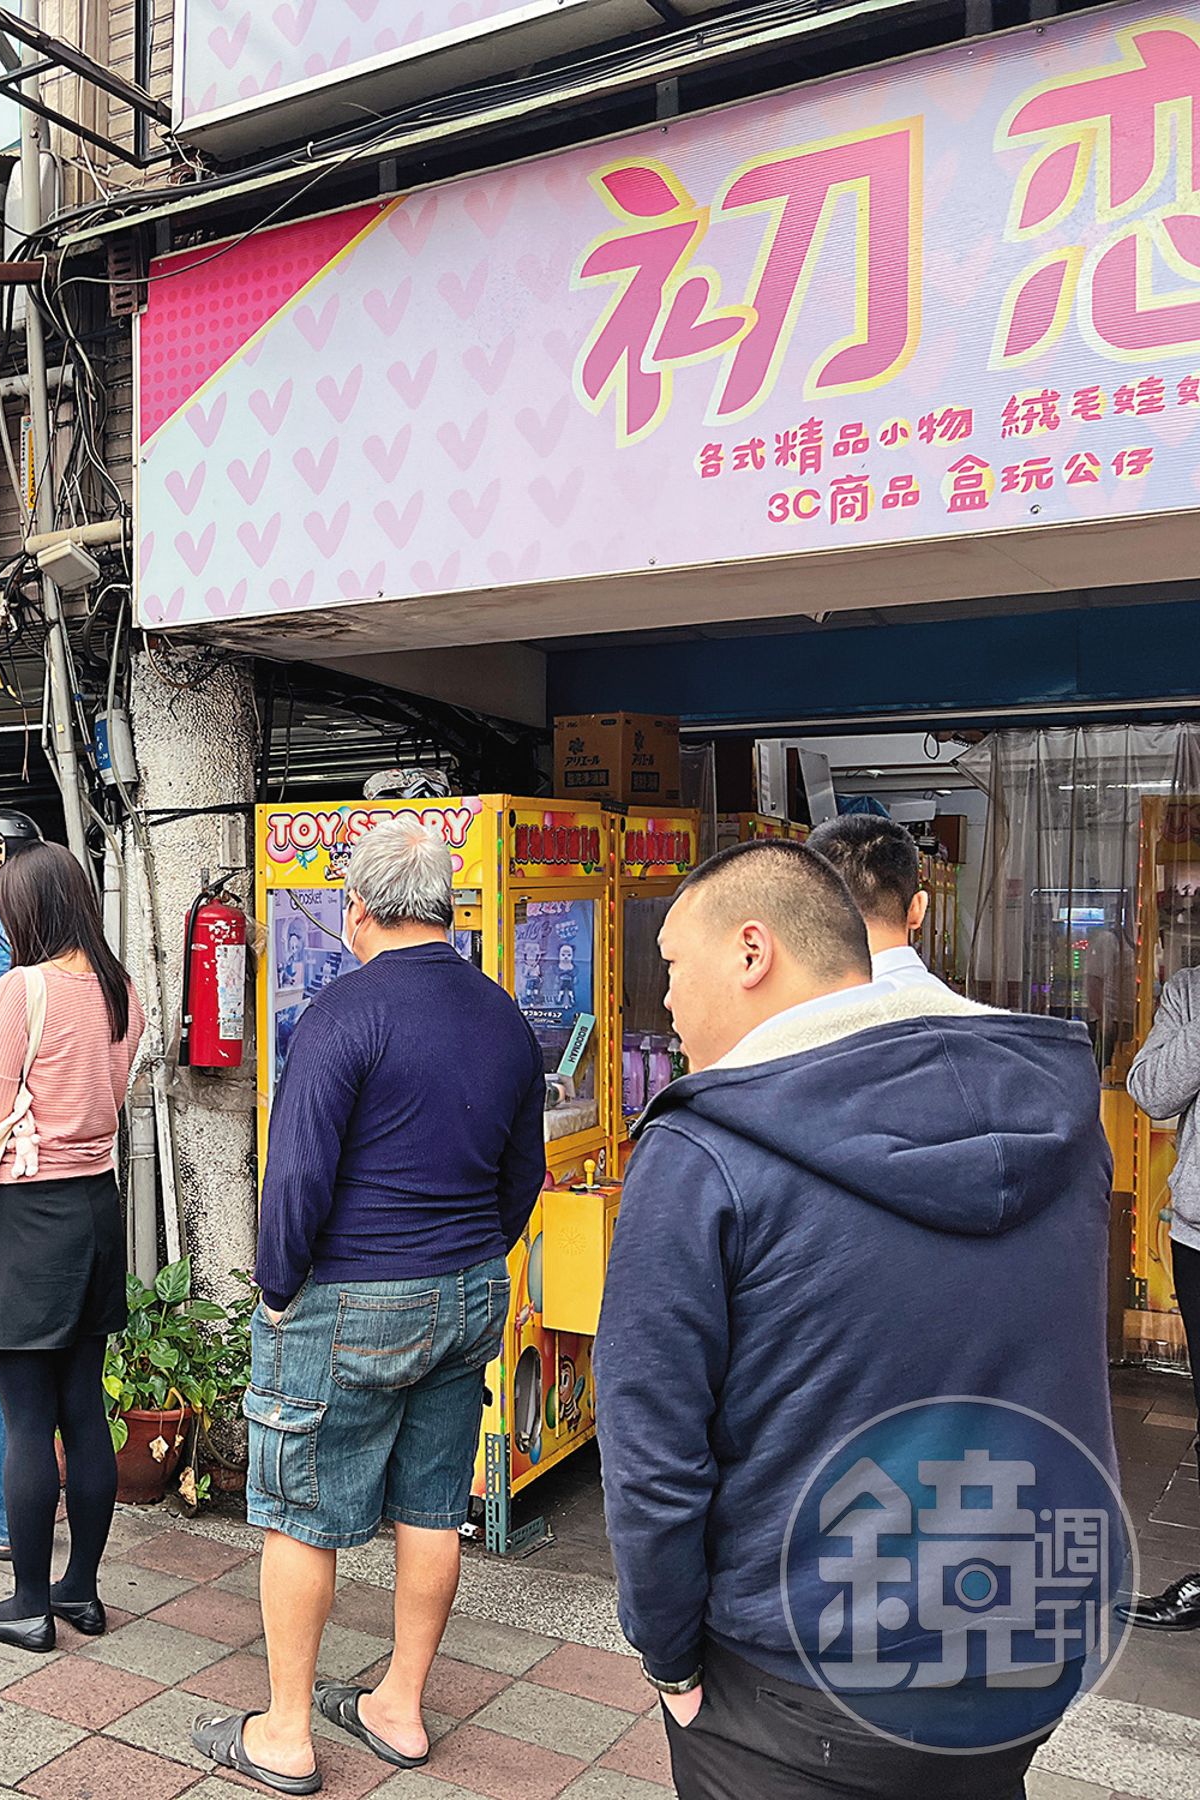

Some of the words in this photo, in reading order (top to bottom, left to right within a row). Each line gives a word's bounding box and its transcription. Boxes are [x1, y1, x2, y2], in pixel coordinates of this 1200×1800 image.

[699, 407, 975, 480] 各式精品小物
[767, 473, 922, 526] 3C商品
[945, 446, 1155, 514] 盒玩公仔
[269, 812, 342, 849] TOY
[348, 808, 473, 848] SRY
